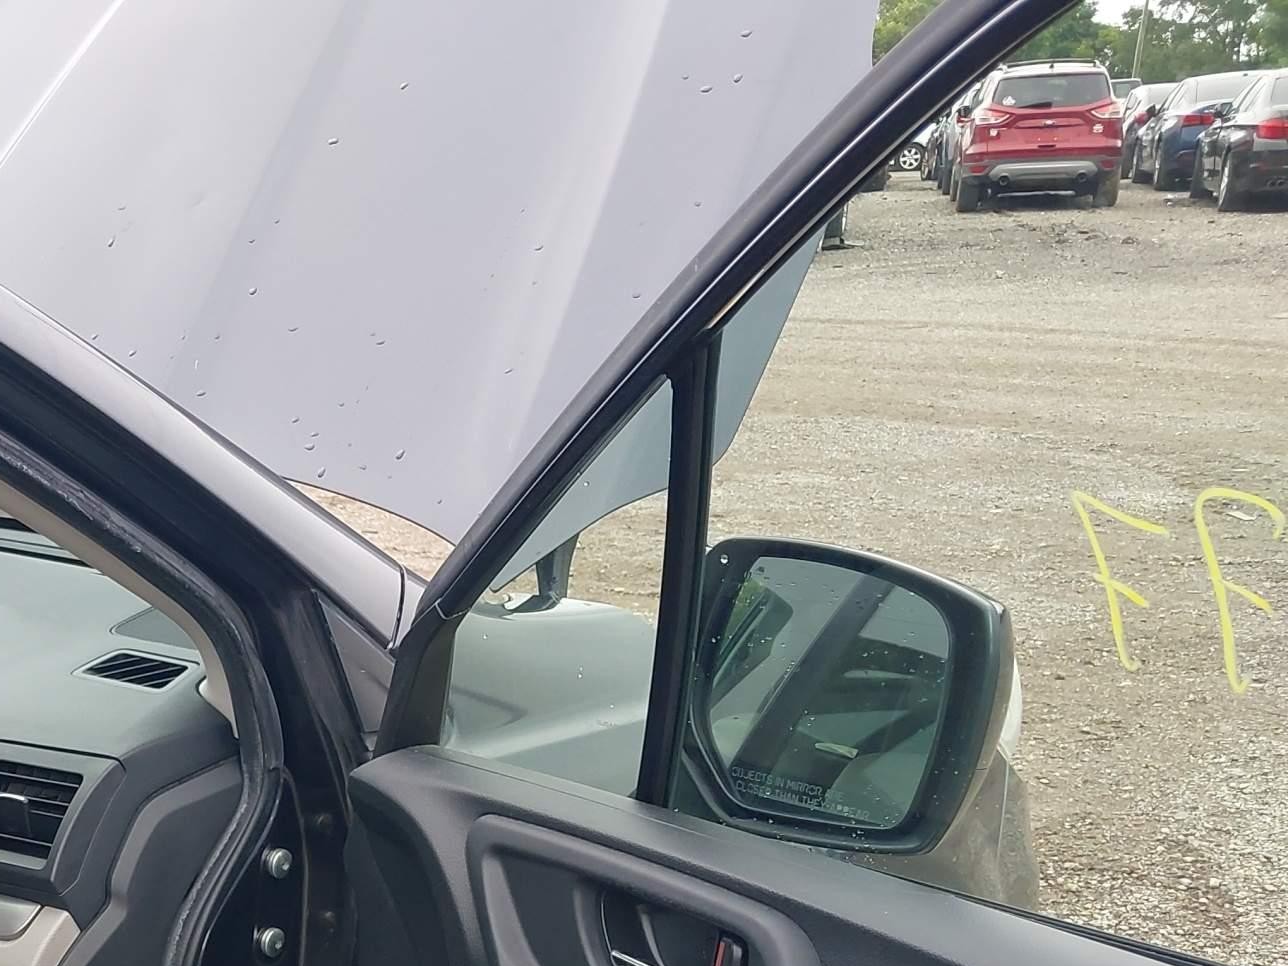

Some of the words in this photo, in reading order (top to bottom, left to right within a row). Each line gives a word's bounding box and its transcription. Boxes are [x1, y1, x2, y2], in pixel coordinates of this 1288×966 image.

[731, 766, 774, 785] OBJECTS
[786, 780, 823, 797] MIRROR
[775, 789, 800, 804] THAN
[802, 795, 827, 809] THEY
